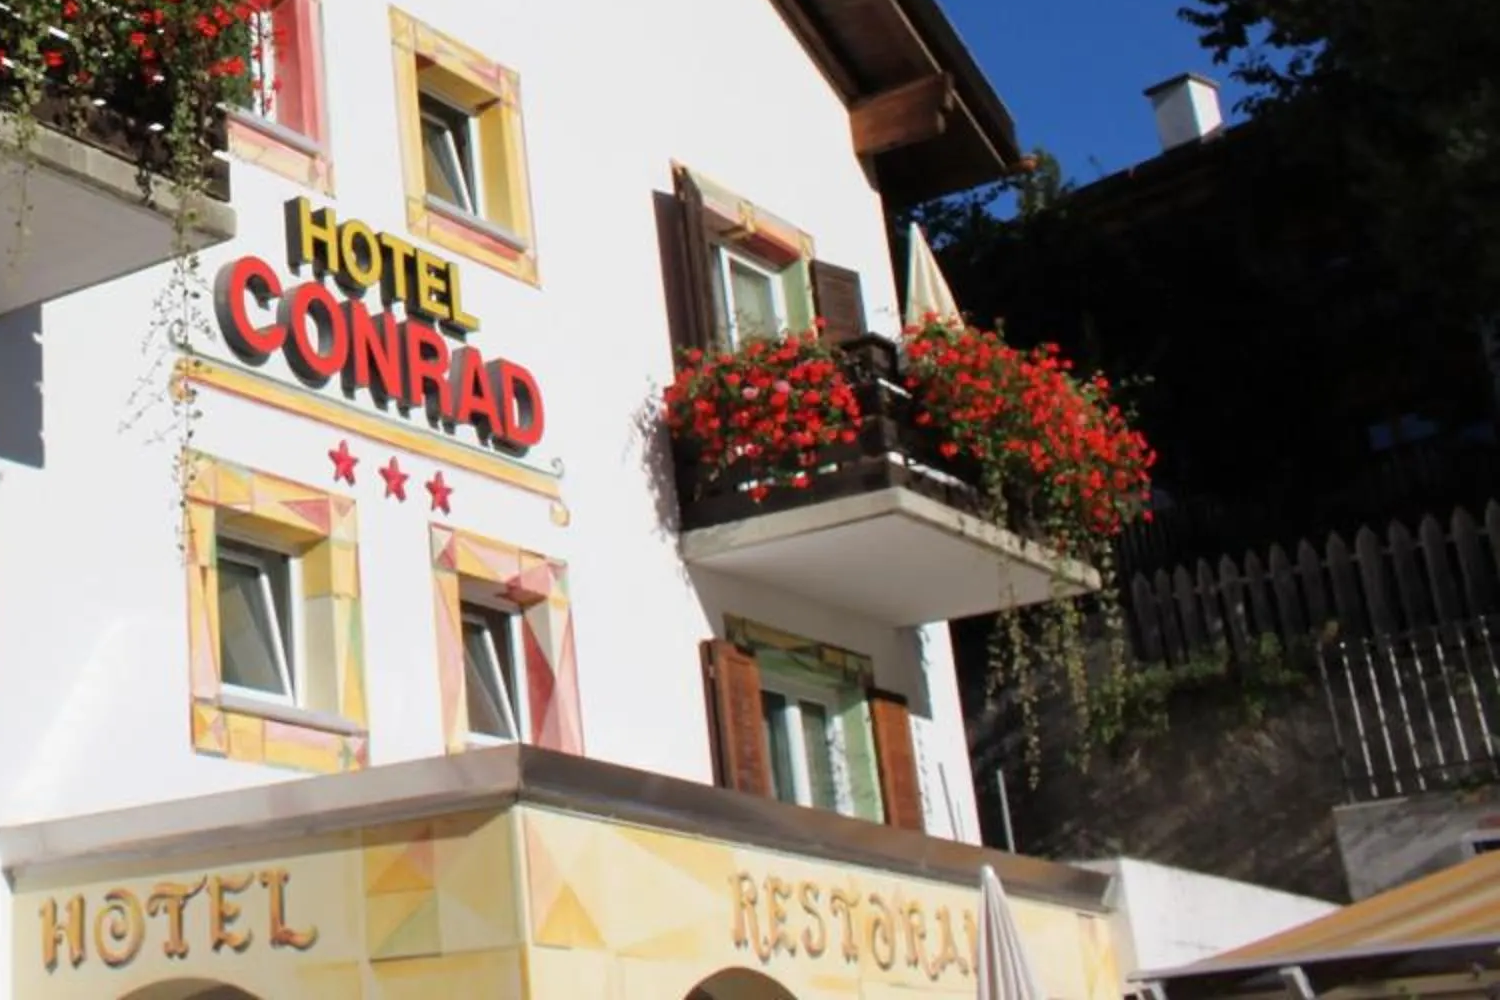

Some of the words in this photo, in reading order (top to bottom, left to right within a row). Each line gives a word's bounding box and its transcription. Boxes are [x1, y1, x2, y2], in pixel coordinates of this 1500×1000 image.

[285, 196, 480, 340] HOTEL
[215, 256, 545, 457] CONRAD
[39, 867, 318, 974] HOTEL
